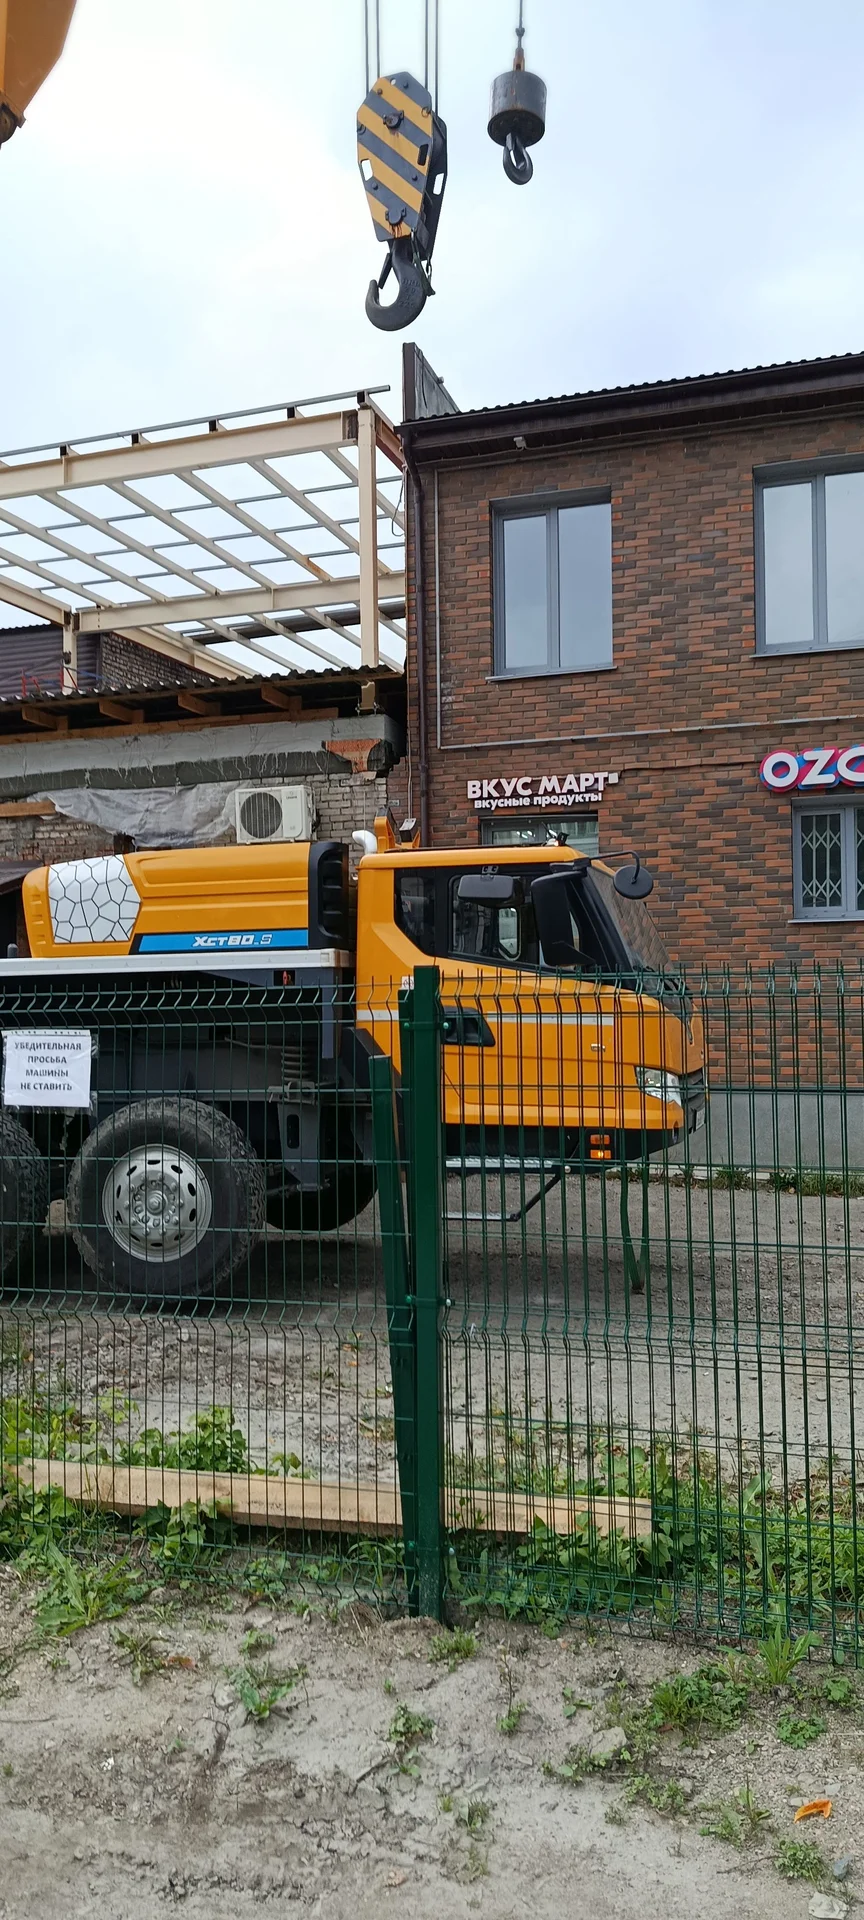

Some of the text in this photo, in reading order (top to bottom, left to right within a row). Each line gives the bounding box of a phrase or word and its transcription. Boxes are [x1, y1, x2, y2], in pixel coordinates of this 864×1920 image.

[467, 772, 608, 799] ВКУС МАРТ
[474, 793, 602, 810] вкусные продукты
[14, 1042, 82, 1051] УБЕДИТЕЛЬНАЯ
[27, 1056, 67, 1064] ПРОСЬБА
[25, 1069, 69, 1077] МАШИНЫ
[20, 1082, 73, 1091] НЕ СТАВИТЬ
